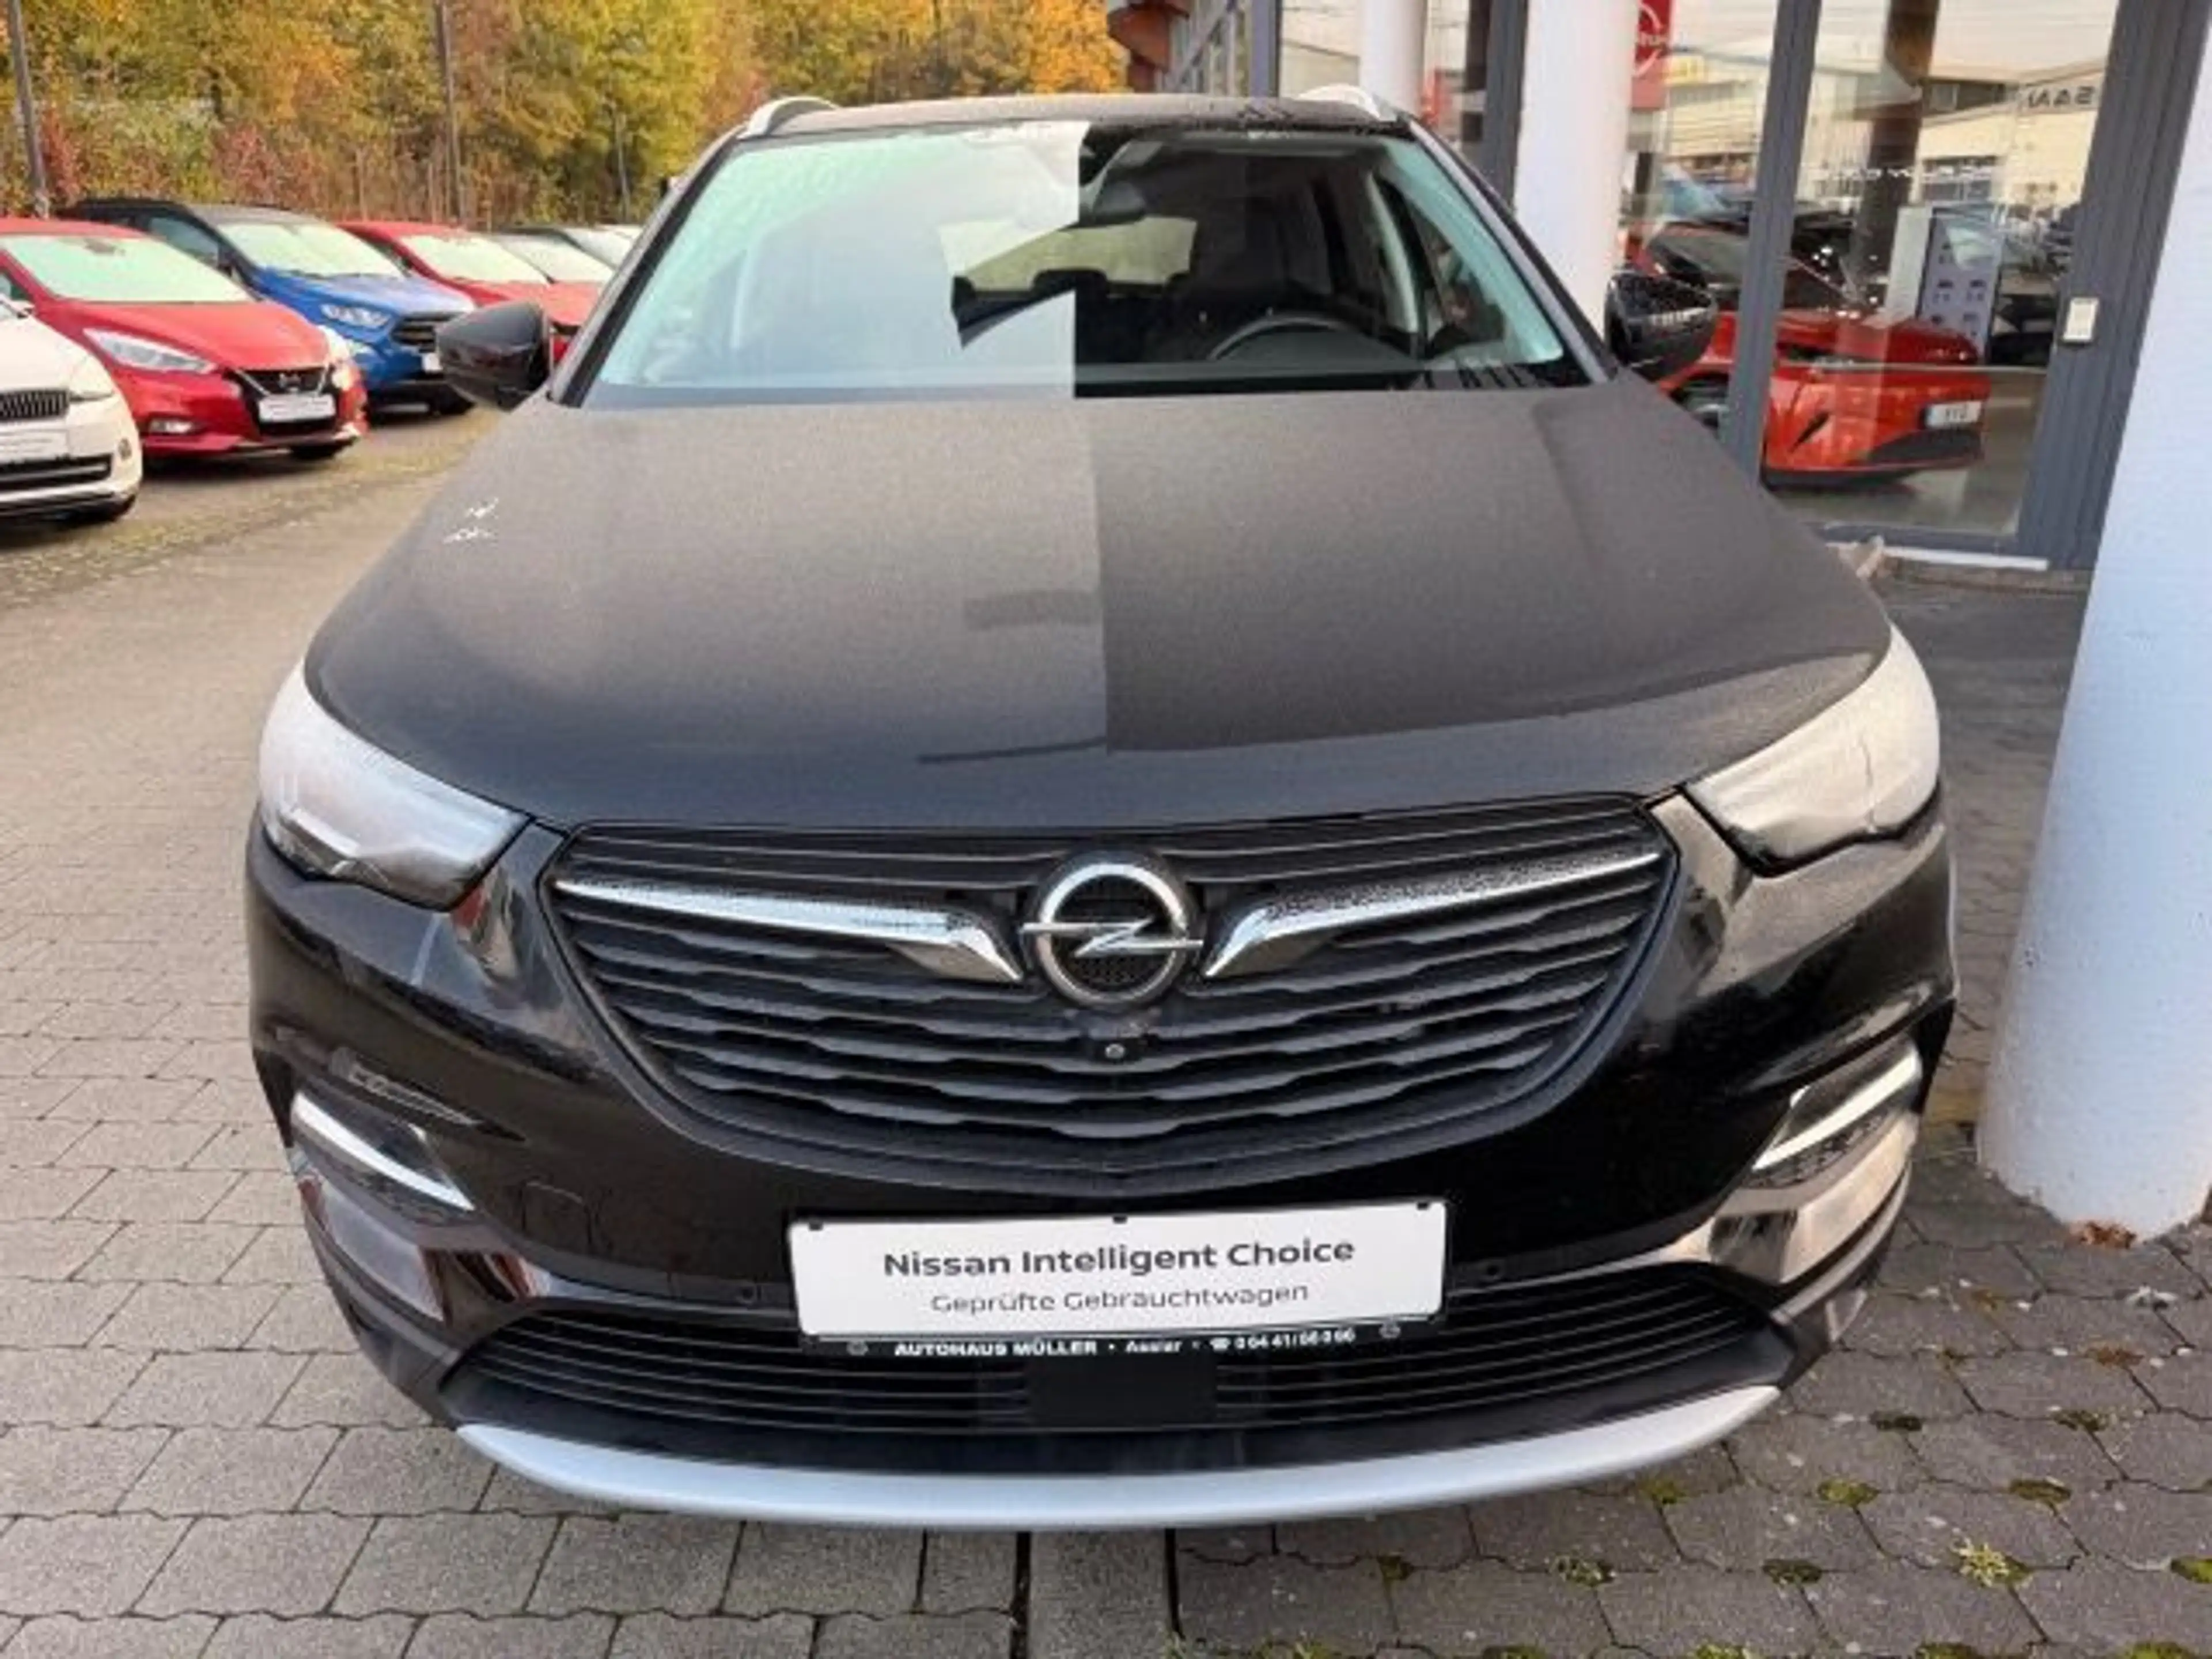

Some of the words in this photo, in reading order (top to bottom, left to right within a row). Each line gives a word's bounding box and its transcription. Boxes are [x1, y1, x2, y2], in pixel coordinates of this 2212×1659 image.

[884, 1251, 1010, 1276] Nissan
[1022, 1244, 1217, 1276] Intelligent
[1227, 1236, 1355, 1266] Choice
[930, 1292, 1055, 1315] Geprüfte
[1065, 1285, 1308, 1308] Gebrauchtwagen
[894, 1342, 1007, 1356] AUTOHAUS
[1012, 1338, 1097, 1355] MÜLLER
